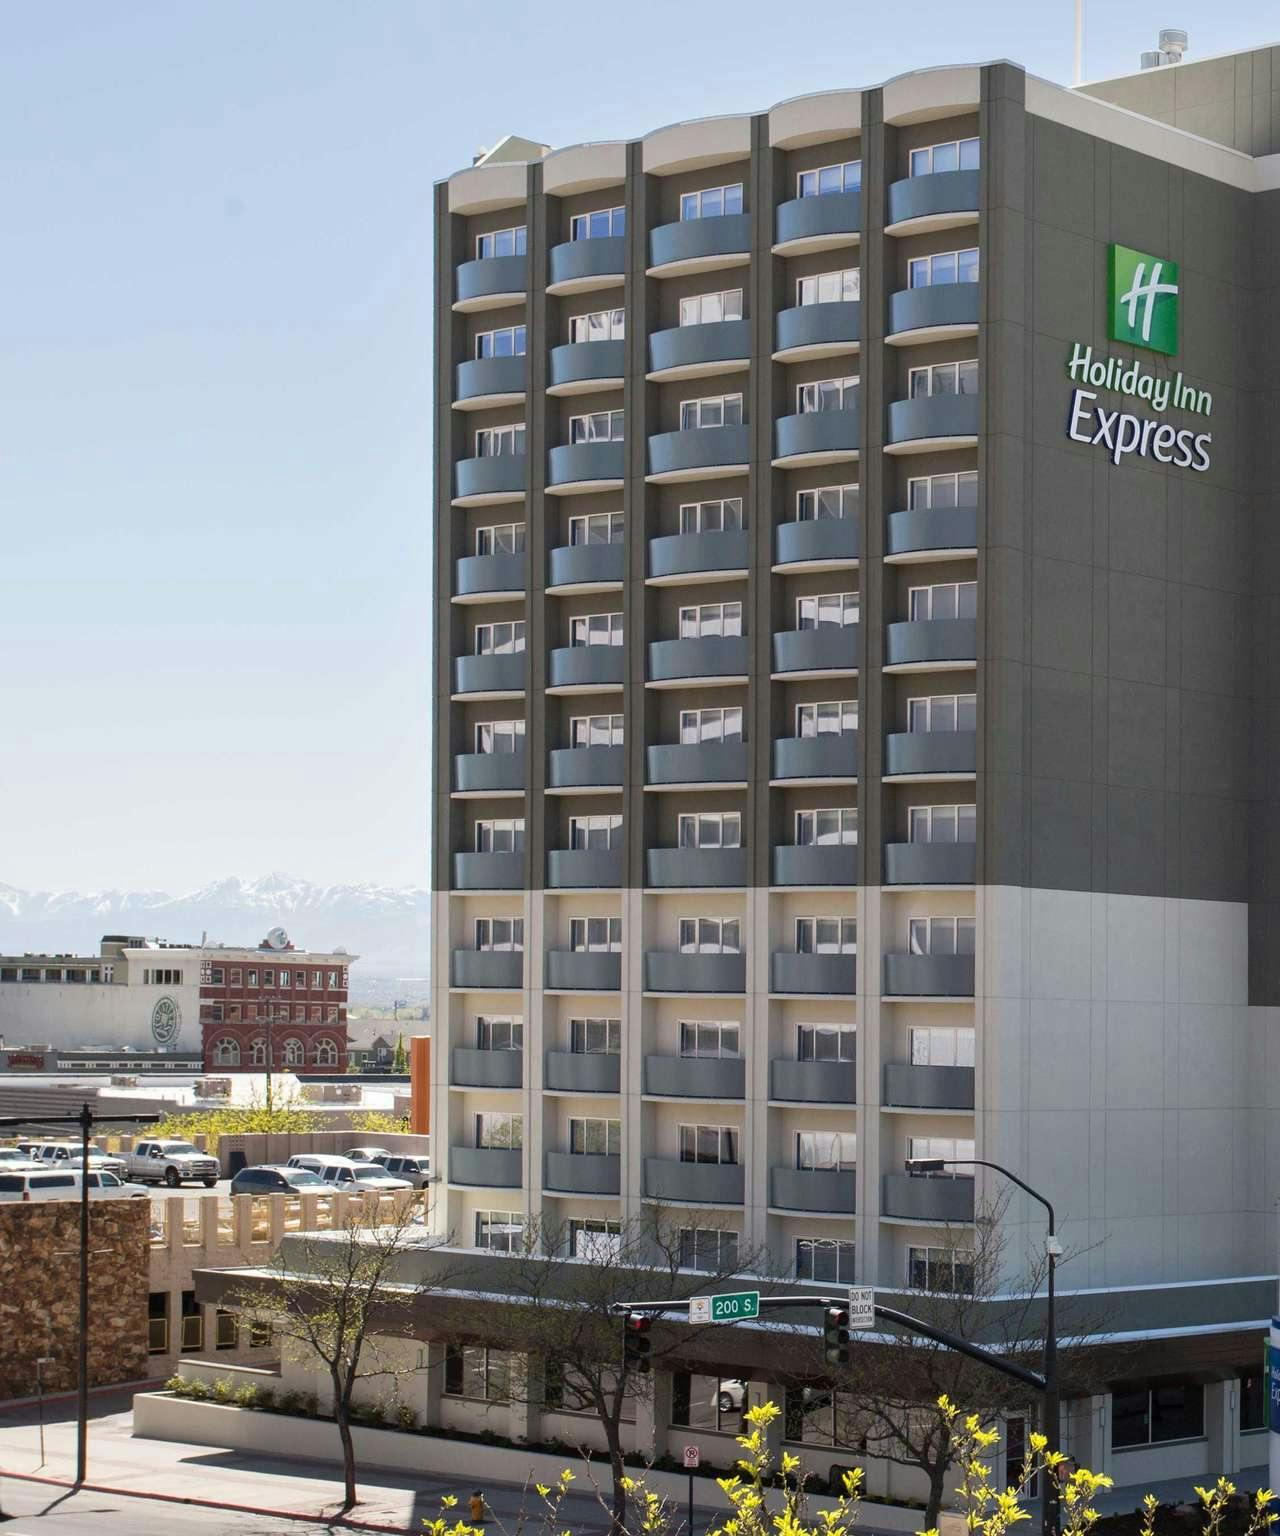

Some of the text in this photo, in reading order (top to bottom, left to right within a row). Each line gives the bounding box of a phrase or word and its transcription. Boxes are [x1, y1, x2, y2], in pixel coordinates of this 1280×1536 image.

[1068, 342, 1213, 417] Holiday Inn
[1068, 388, 1213, 473] Express
[851, 1290, 873, 1302] DO NOT
[716, 1298, 754, 1315] 200 S.
[851, 1304, 872, 1315] BLOCK
